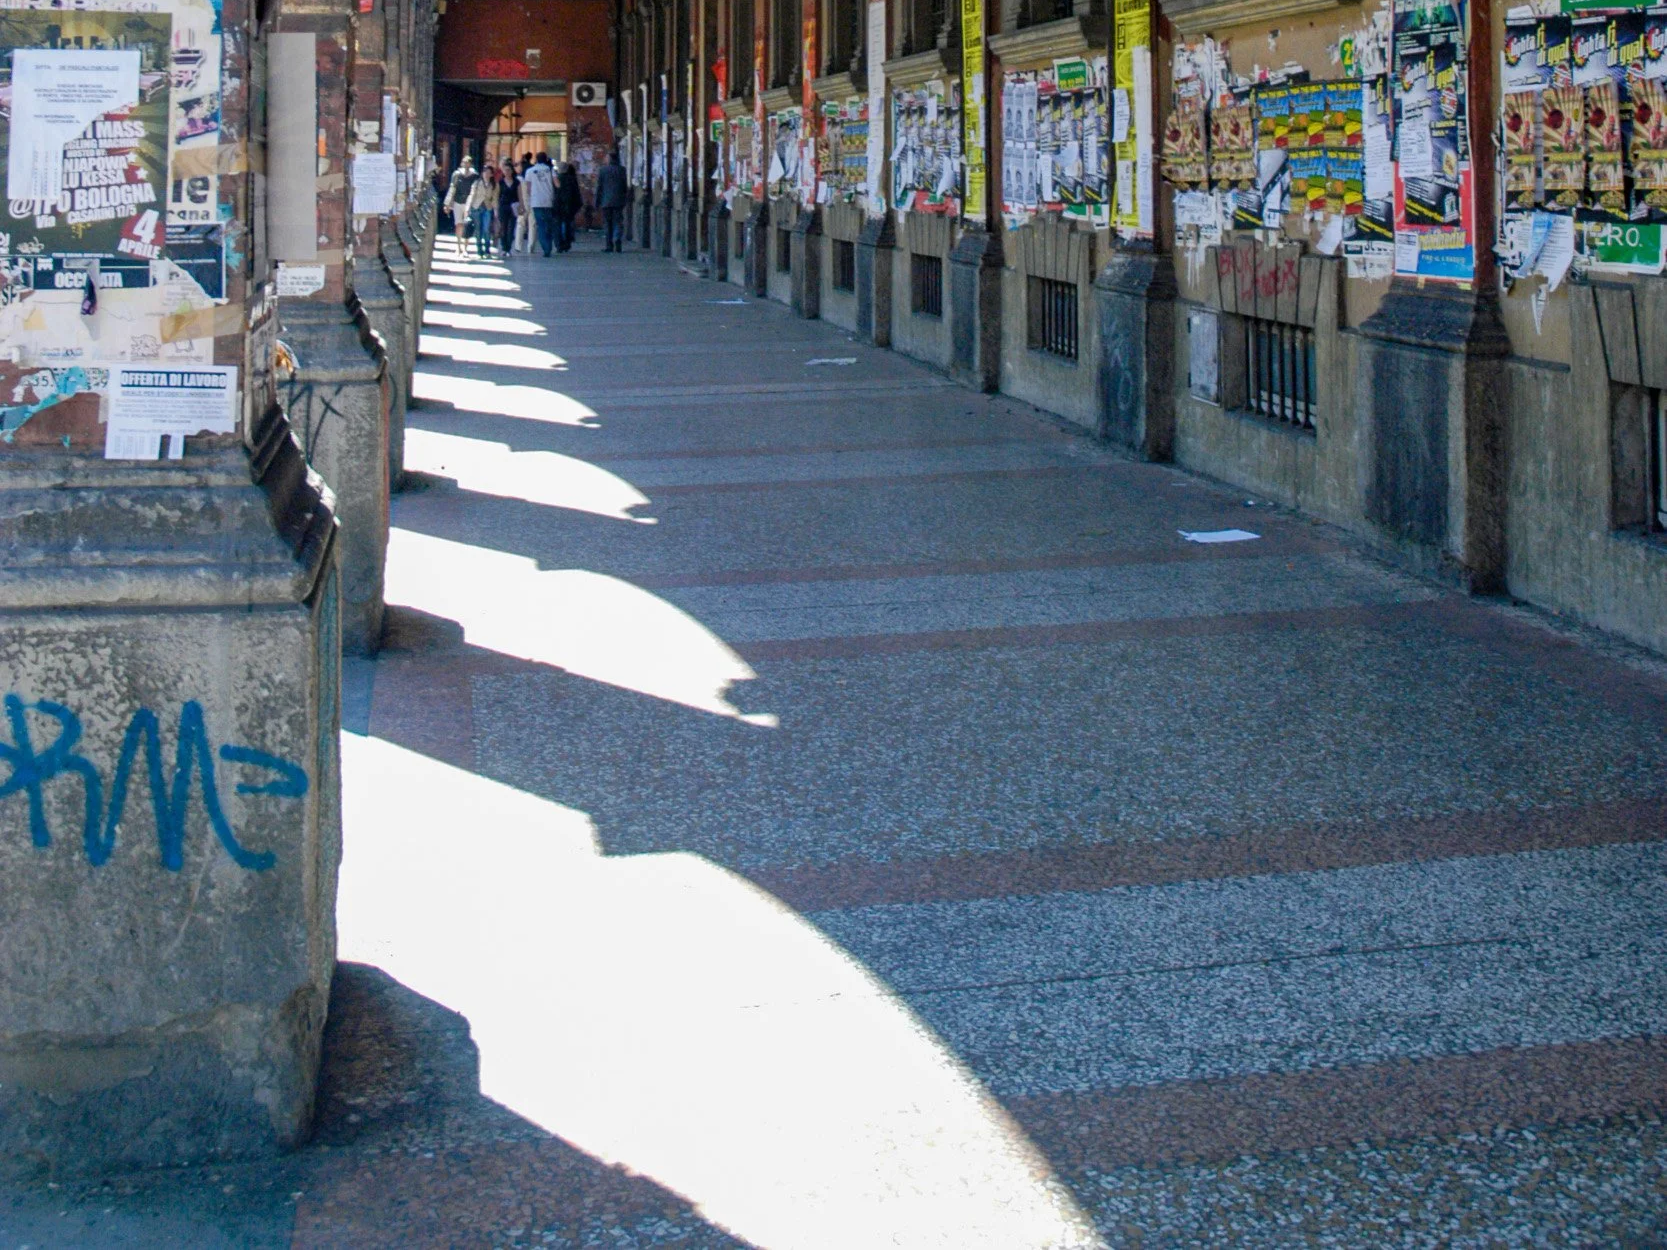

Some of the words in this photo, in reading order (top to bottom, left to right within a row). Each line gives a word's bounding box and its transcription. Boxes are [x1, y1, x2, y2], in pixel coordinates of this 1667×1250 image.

[1343, 43, 1352, 64] 2
[96, 120, 146, 139] MASS
[81, 169, 127, 187] KESSA
[74, 183, 157, 211] BOLOGNA
[36, 215, 56, 229] Via
[67, 206, 116, 224] CASARINI
[133, 209, 159, 244] 4
[117, 237, 161, 260] APRILE
[55, 272, 123, 288] OCCATA
[121, 372, 168, 386] OFFERTA
[169, 373, 182, 386] DI
[183, 373, 227, 388] LAVORO
